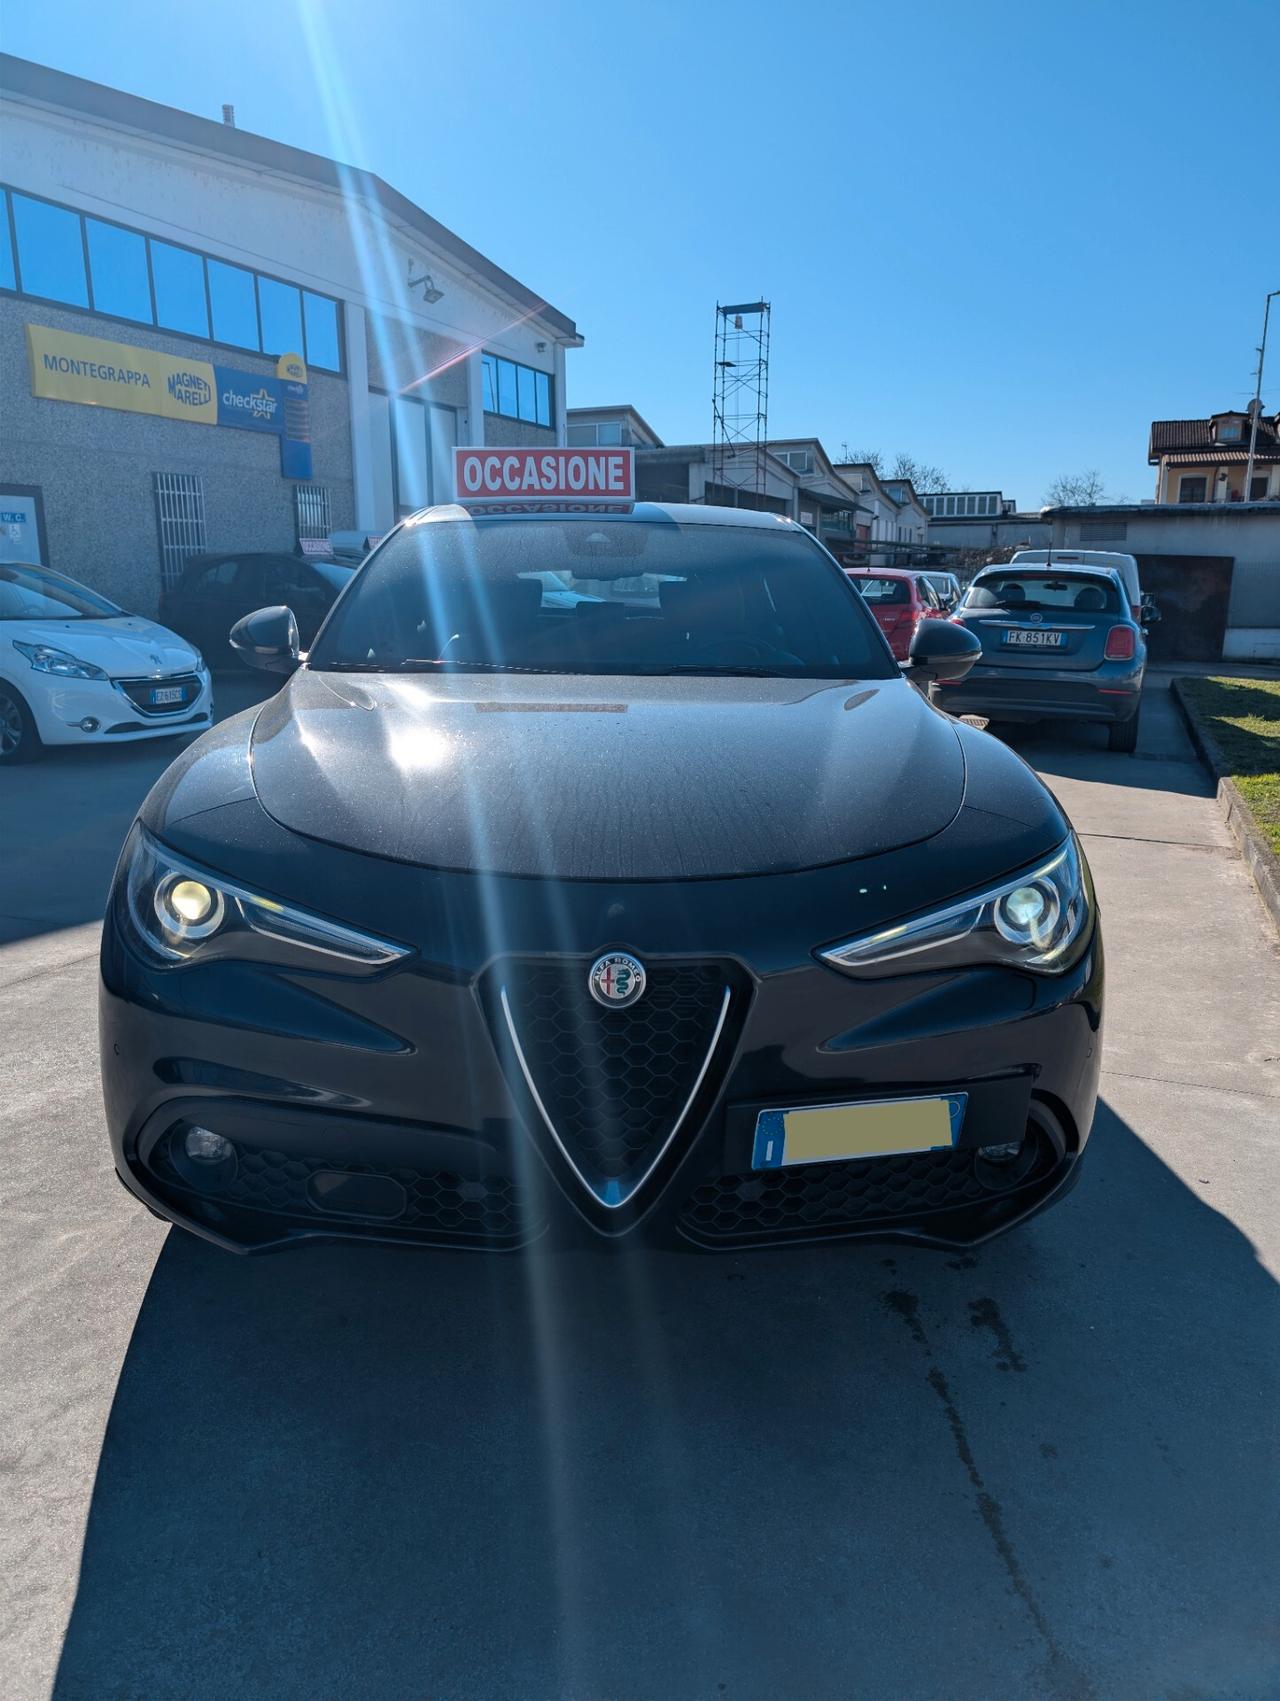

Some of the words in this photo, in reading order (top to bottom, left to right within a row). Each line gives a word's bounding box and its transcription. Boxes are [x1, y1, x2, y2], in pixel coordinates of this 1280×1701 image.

[43, 353, 151, 389] MONTEGRAPPA
[222, 389, 278, 413] checkstar
[463, 455, 625, 491] OCCASIONE
[594, 960, 611, 981] ALFA
[615, 957, 641, 982] ROMEO
